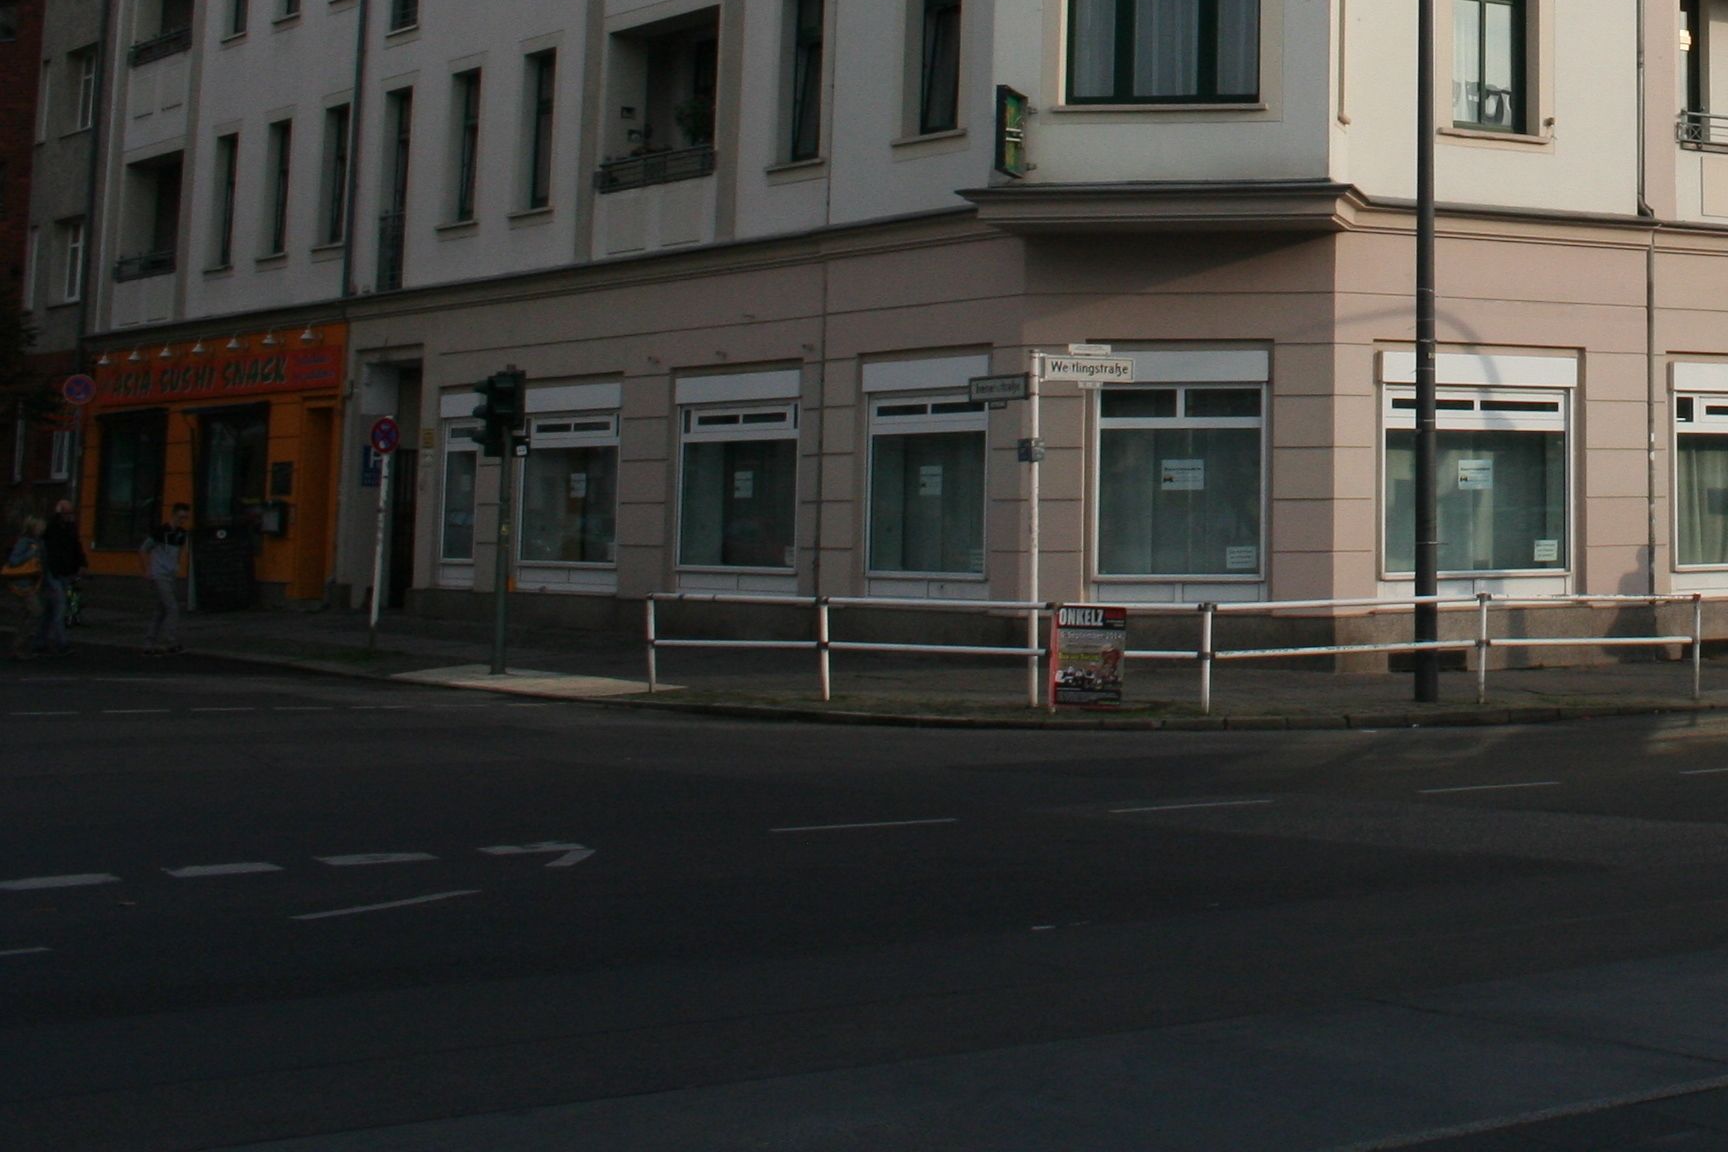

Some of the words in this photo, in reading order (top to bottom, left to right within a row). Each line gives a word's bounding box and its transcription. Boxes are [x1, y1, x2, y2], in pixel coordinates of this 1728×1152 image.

[1051, 360, 1129, 377] Wetlingstraße
[160, 364, 217, 394] SUSHI
[1059, 608, 1104, 627] ONKELZ
